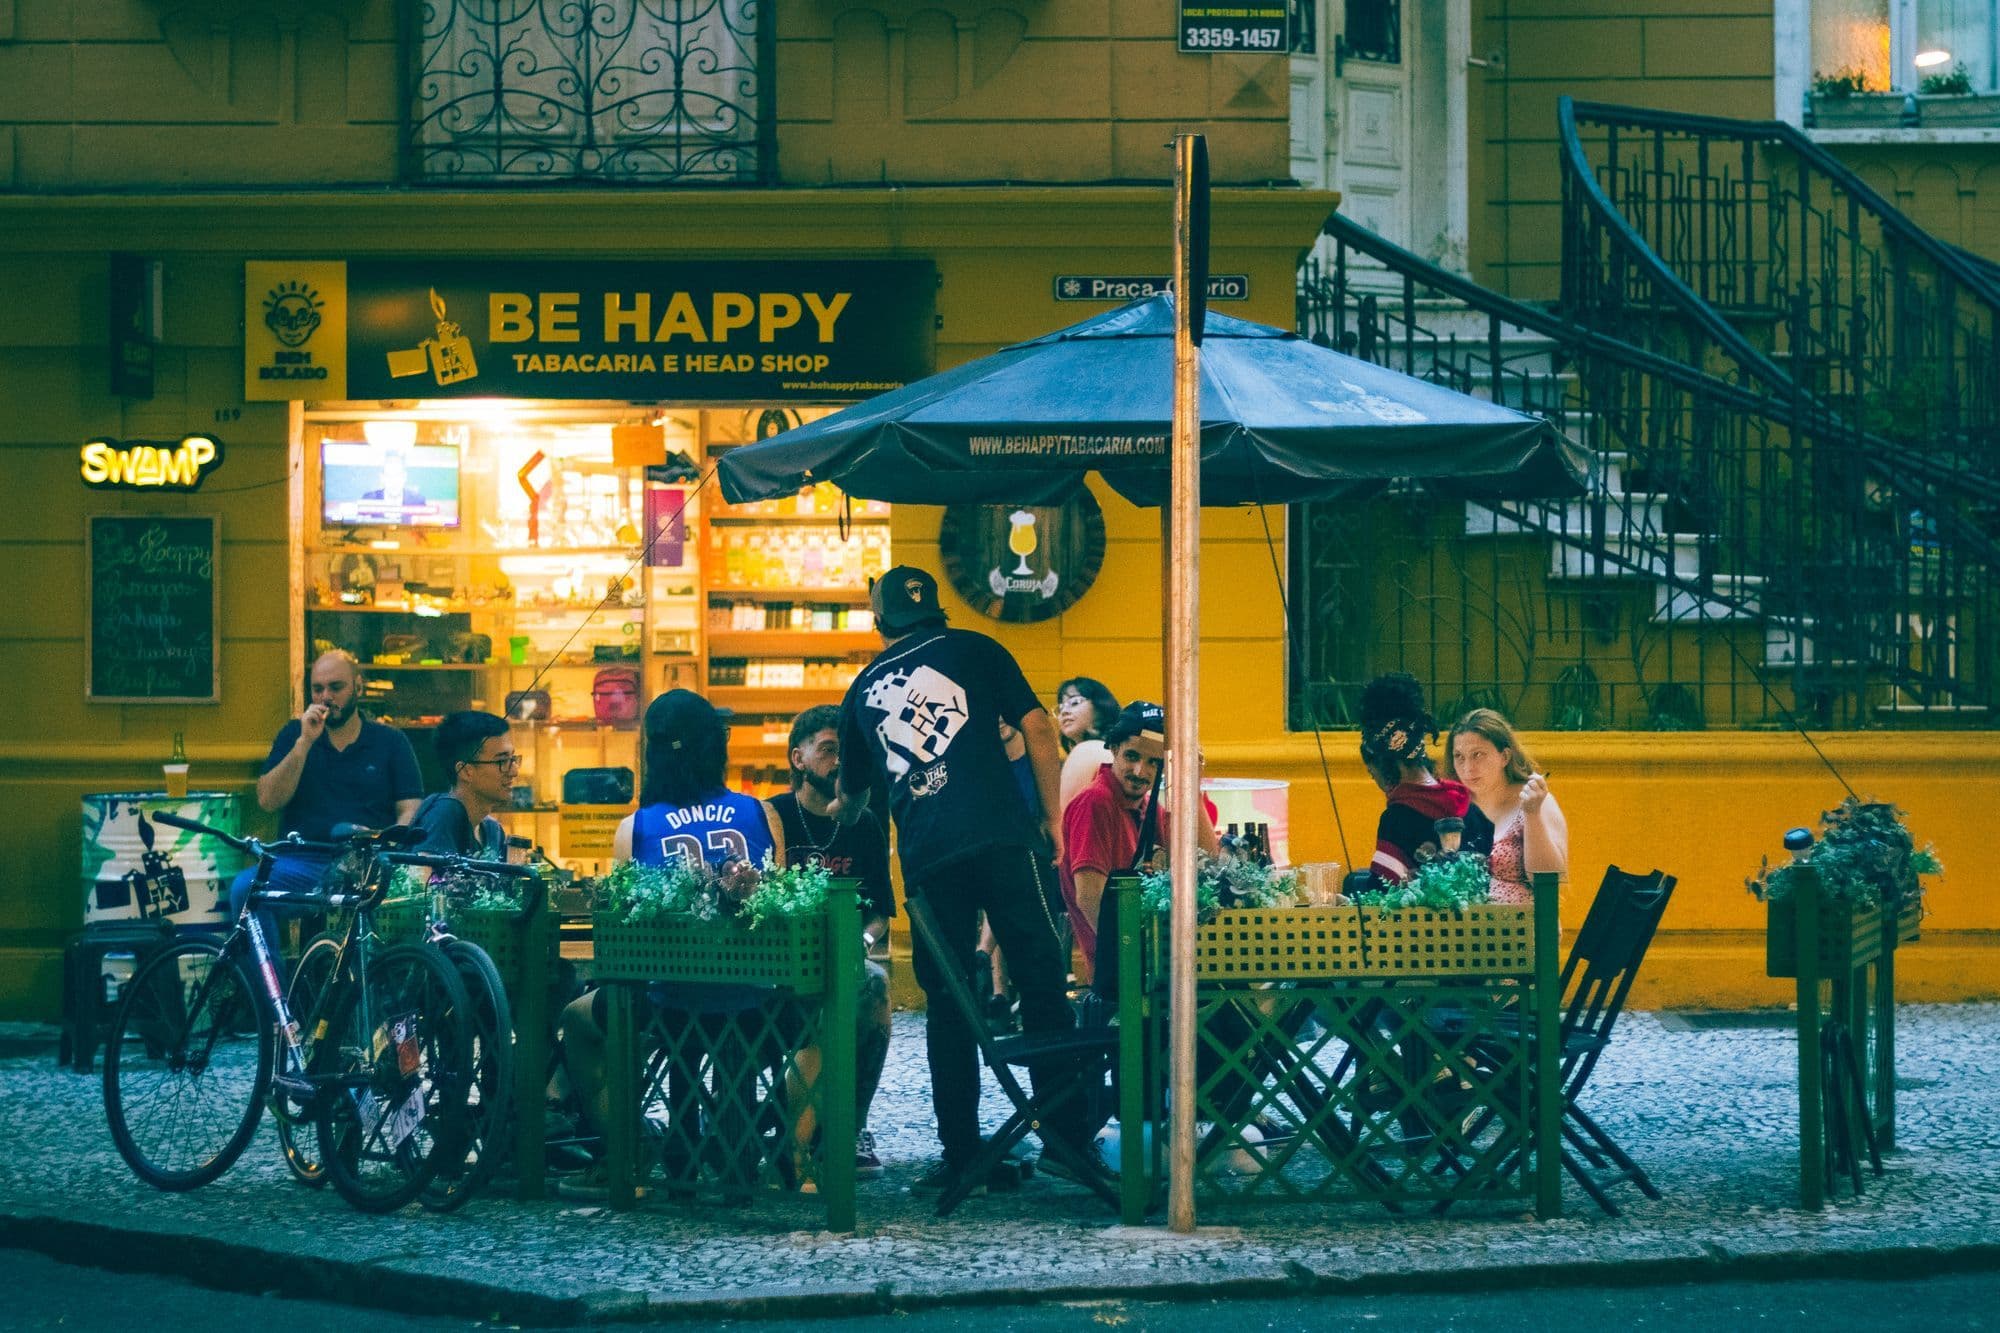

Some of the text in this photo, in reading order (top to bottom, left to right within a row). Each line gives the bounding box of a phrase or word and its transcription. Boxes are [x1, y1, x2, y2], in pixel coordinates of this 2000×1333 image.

[1186, 27, 1281, 48] 3359-1457
[1092, 279, 1154, 299] Praça
[488, 292, 852, 344] BE HAPPY
[259, 367, 328, 380] BOLADO
[512, 354, 831, 374] TABACARIA E HEAD SHOP
[969, 434, 1165, 456] WWW.BEHAPPYTABACARIA.COM
[81, 437, 216, 486] SWAMP
[665, 804, 736, 830] DONCIC
